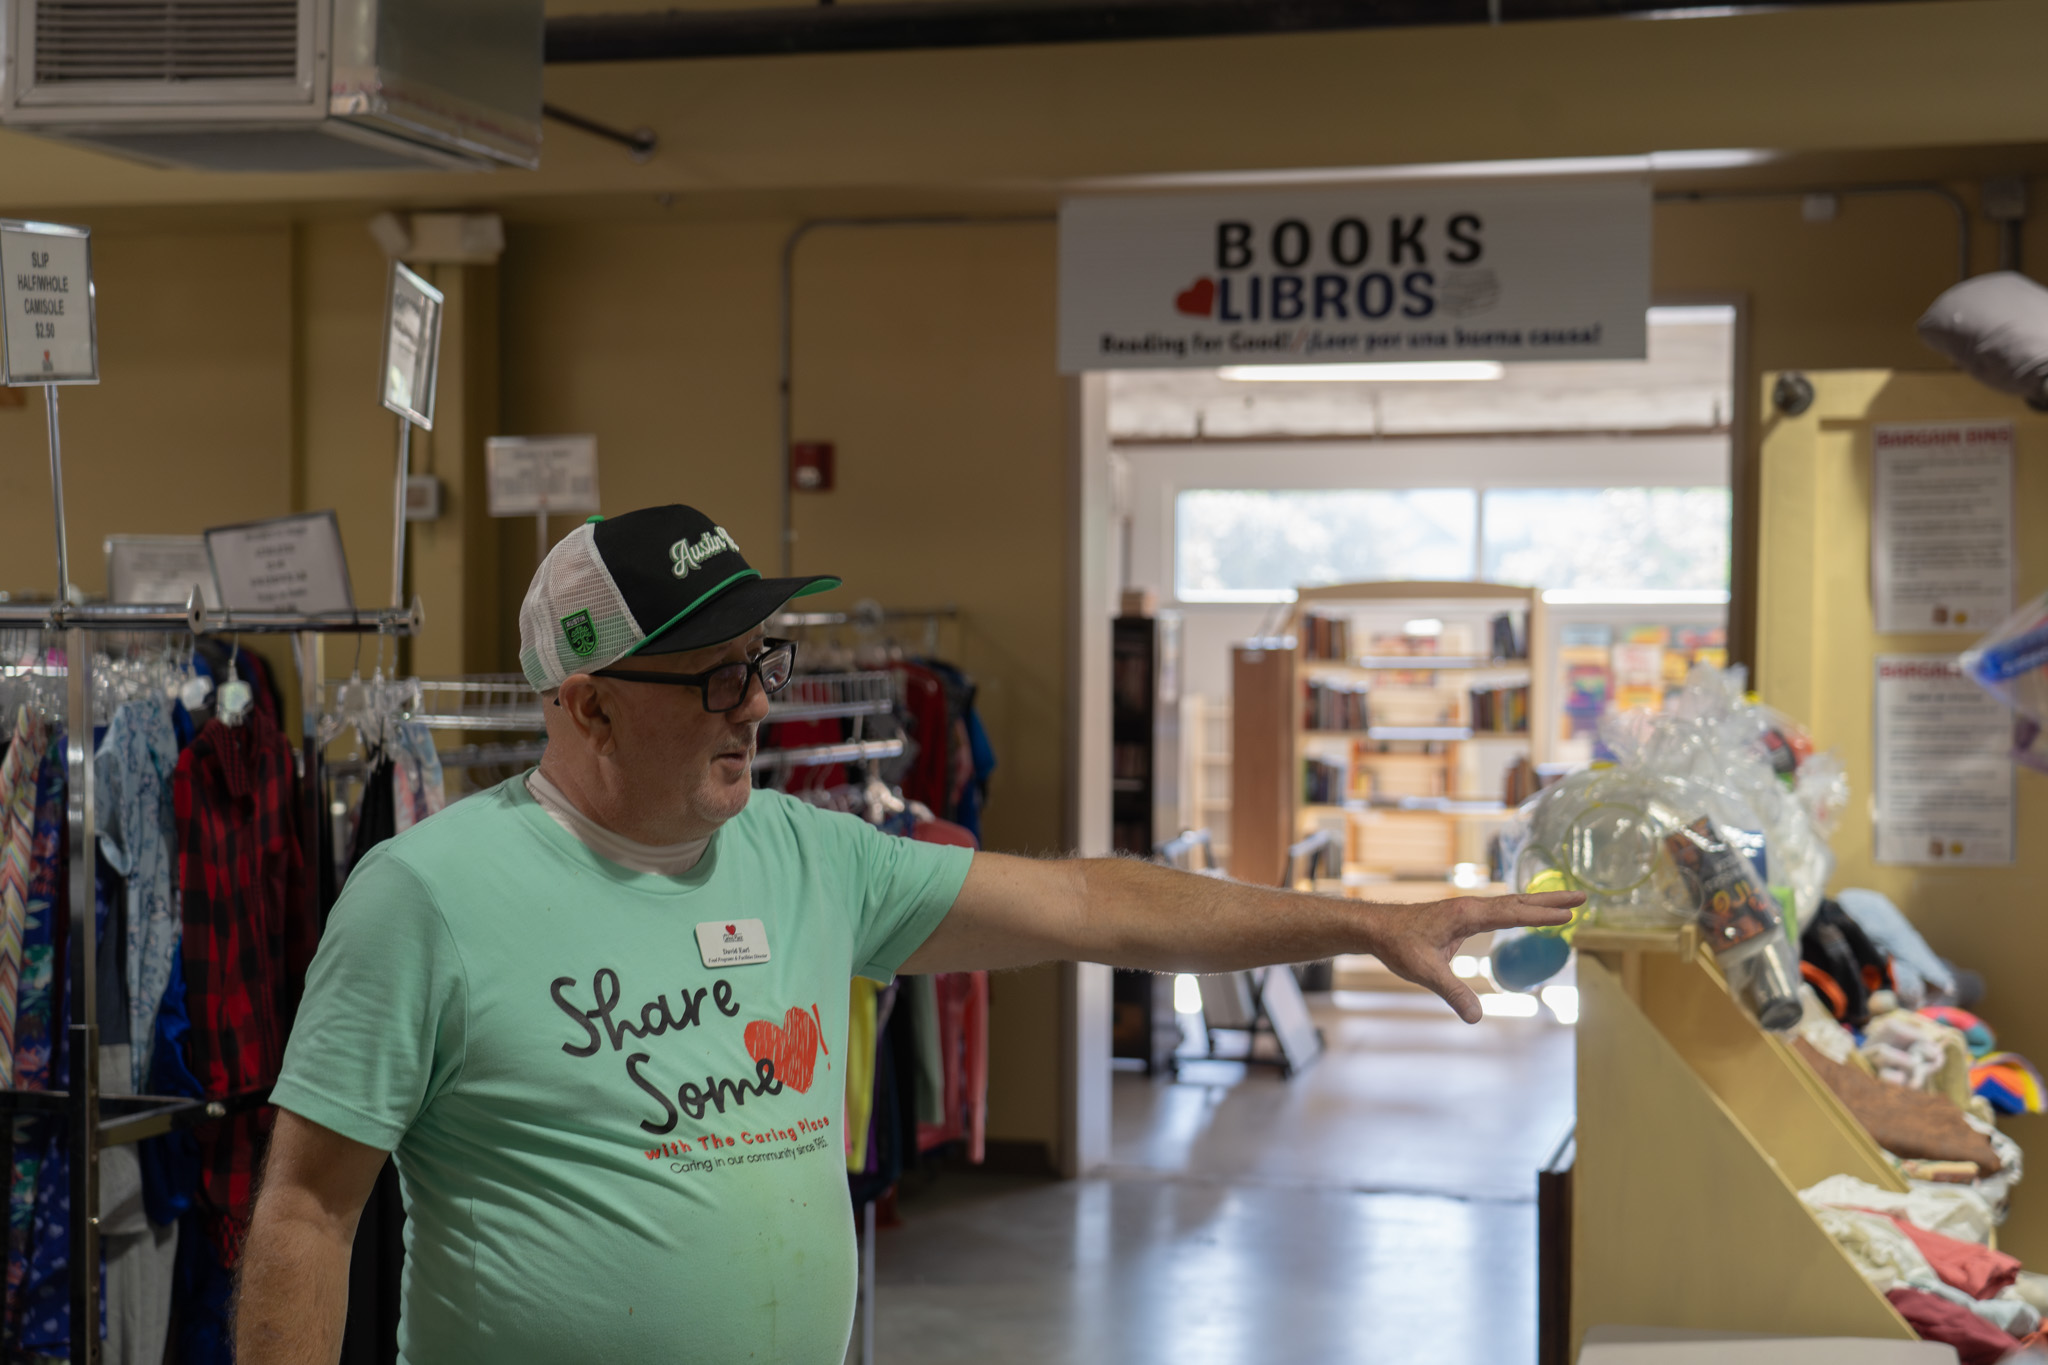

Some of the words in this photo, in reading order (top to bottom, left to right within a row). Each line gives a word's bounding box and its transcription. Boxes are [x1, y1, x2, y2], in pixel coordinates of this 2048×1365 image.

[31, 251, 49, 268] SLIP
[1216, 213, 1485, 270] BOOKS
[24, 298, 65, 316] CAMISOLE
[1219, 271, 1436, 323] LIBROS
[35, 322, 55, 339] $2.50
[669, 531, 727, 579] Austin
[550, 968, 740, 1057] Share
[626, 1053, 783, 1135] Some
[644, 1139, 692, 1160] with
[697, 1133, 735, 1151] The
[740, 1127, 798, 1145] Caring
[797, 1116, 830, 1135] Place
[670, 1158, 713, 1174] Caring
[714, 1156, 726, 1168] in
[727, 1154, 744, 1166] our
[746, 1147, 796, 1164] community
[796, 1143, 816, 1155] since
